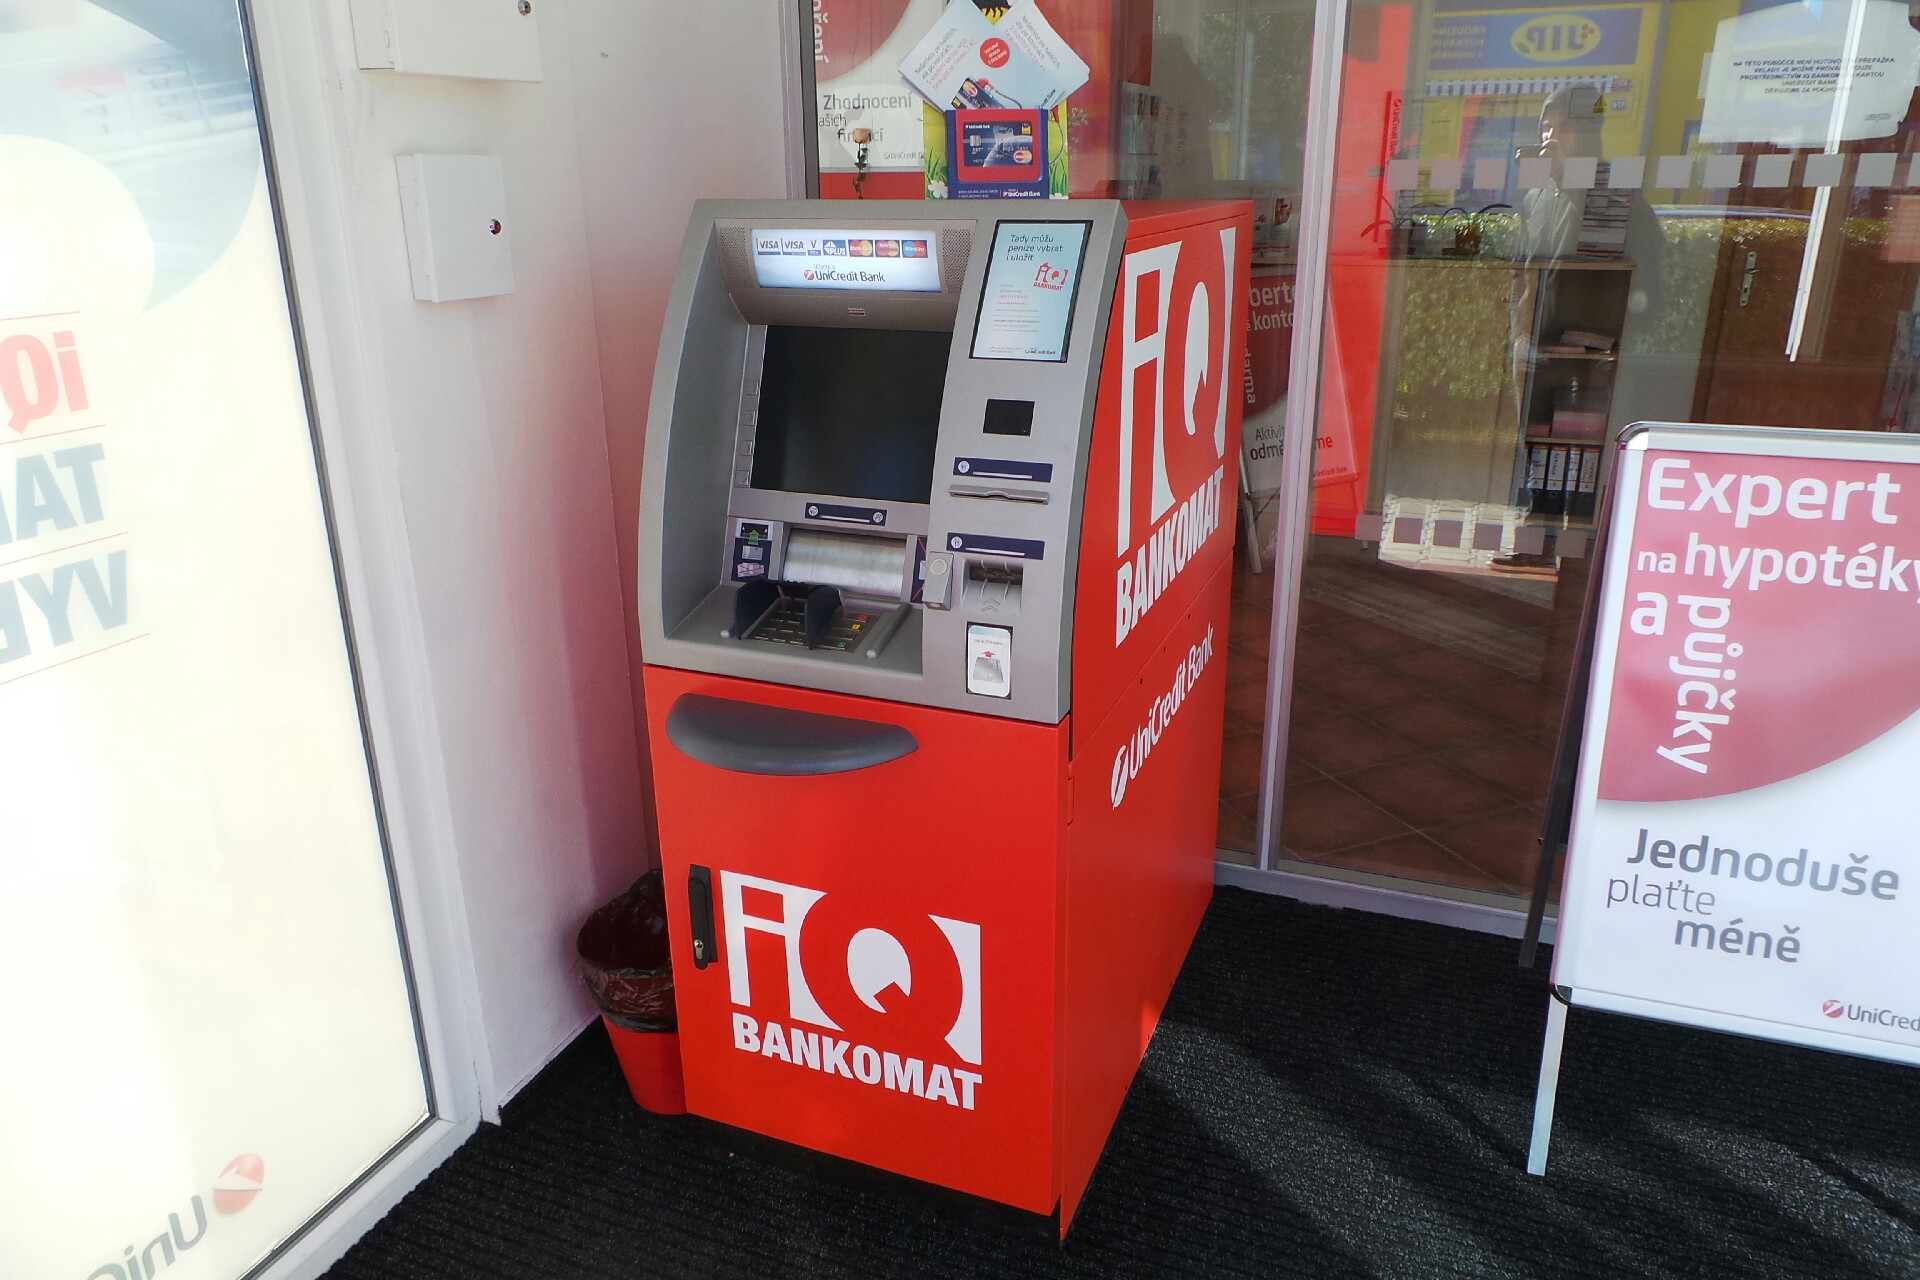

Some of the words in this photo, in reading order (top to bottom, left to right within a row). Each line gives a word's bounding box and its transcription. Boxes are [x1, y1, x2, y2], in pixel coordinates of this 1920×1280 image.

[823, 91, 913, 111] Zhodnocení
[760, 240, 779, 250] VISA
[784, 240, 804, 250] VISA
[831, 247, 846, 256] PLUS
[1007, 243, 1035, 253] peníze
[1036, 243, 1063, 254] vybrat
[1010, 234, 1029, 244] Tady
[1010, 253, 1034, 261] uložit
[815, 269, 859, 282] UniCredit
[860, 270, 886, 283] Bank
[1647, 458, 1900, 528] Expert
[1116, 464, 1224, 648] BANKOMAT
[1637, 549, 1675, 574] na
[1684, 532, 1920, 604] hypoték
[1630, 592, 1668, 636] a
[1128, 660, 1186, 780] UniCredit
[1187, 622, 1214, 693] Bank
[1656, 594, 1744, 775] půjčky
[1627, 828, 1899, 901] Jednoduše
[1606, 874, 1716, 915] plaťte
[1674, 917, 1801, 963] méně
[731, 1011, 983, 1111] BANKOMAT
